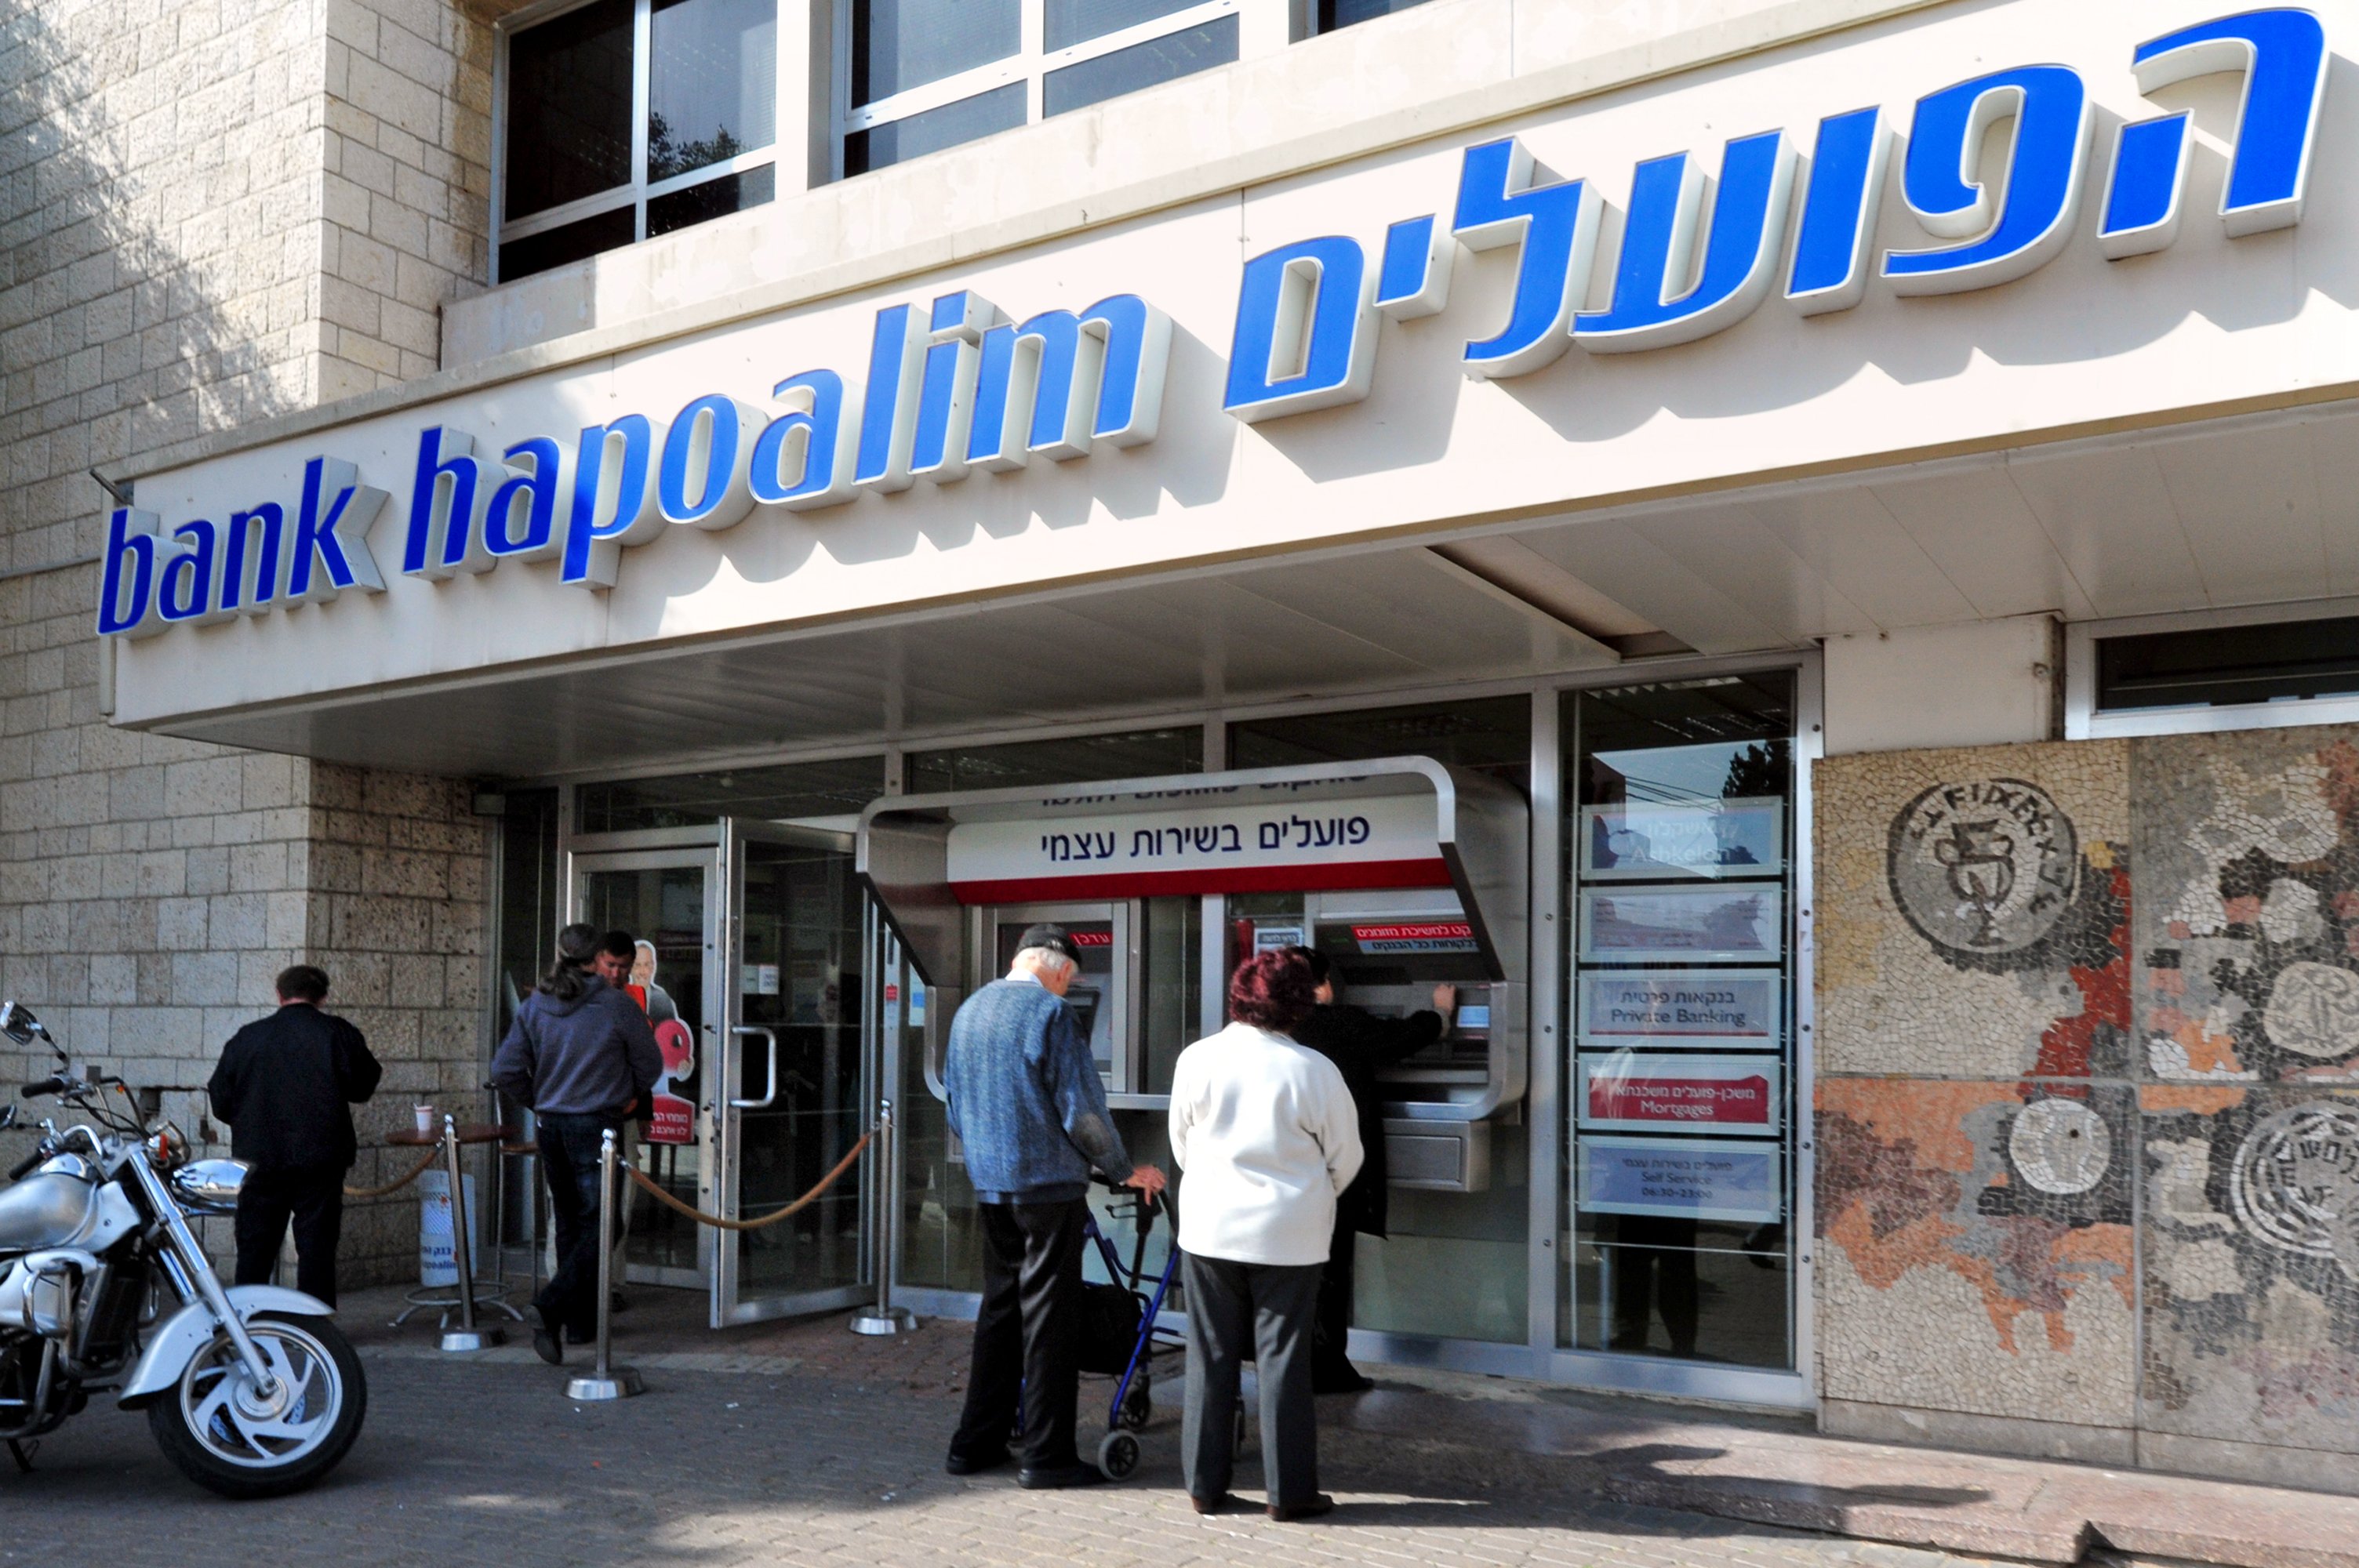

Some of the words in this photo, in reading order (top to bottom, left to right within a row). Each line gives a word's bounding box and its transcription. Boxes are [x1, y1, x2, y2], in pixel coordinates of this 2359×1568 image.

[1222, 8, 2327, 411] הפועלים
[96, 455, 359, 637] bank
[402, 289, 1150, 586] hapoalim
[1259, 815, 1371, 850] פועלים
[1041, 830, 1116, 862] עצמי
[1129, 824, 1241, 858] בשירות
[1357, 927, 1400, 938] מזומנים
[1401, 925, 1450, 937] למשיכת
[1451, 925, 1472, 937] קט
[1412, 939, 1430, 949] כל
[1620, 991, 1670, 1004] פרטית
[1674, 991, 1736, 1004] בנקאות
[1611, 1008, 1671, 1023] Private
[1676, 1008, 1747, 1028] Banking
[1616, 1084, 1668, 1097] משכנתא
[1640, 1100, 1714, 1119] Mortgages
[1641, 1171, 1663, 1183] Self
[1667, 1172, 1713, 1185] Service
